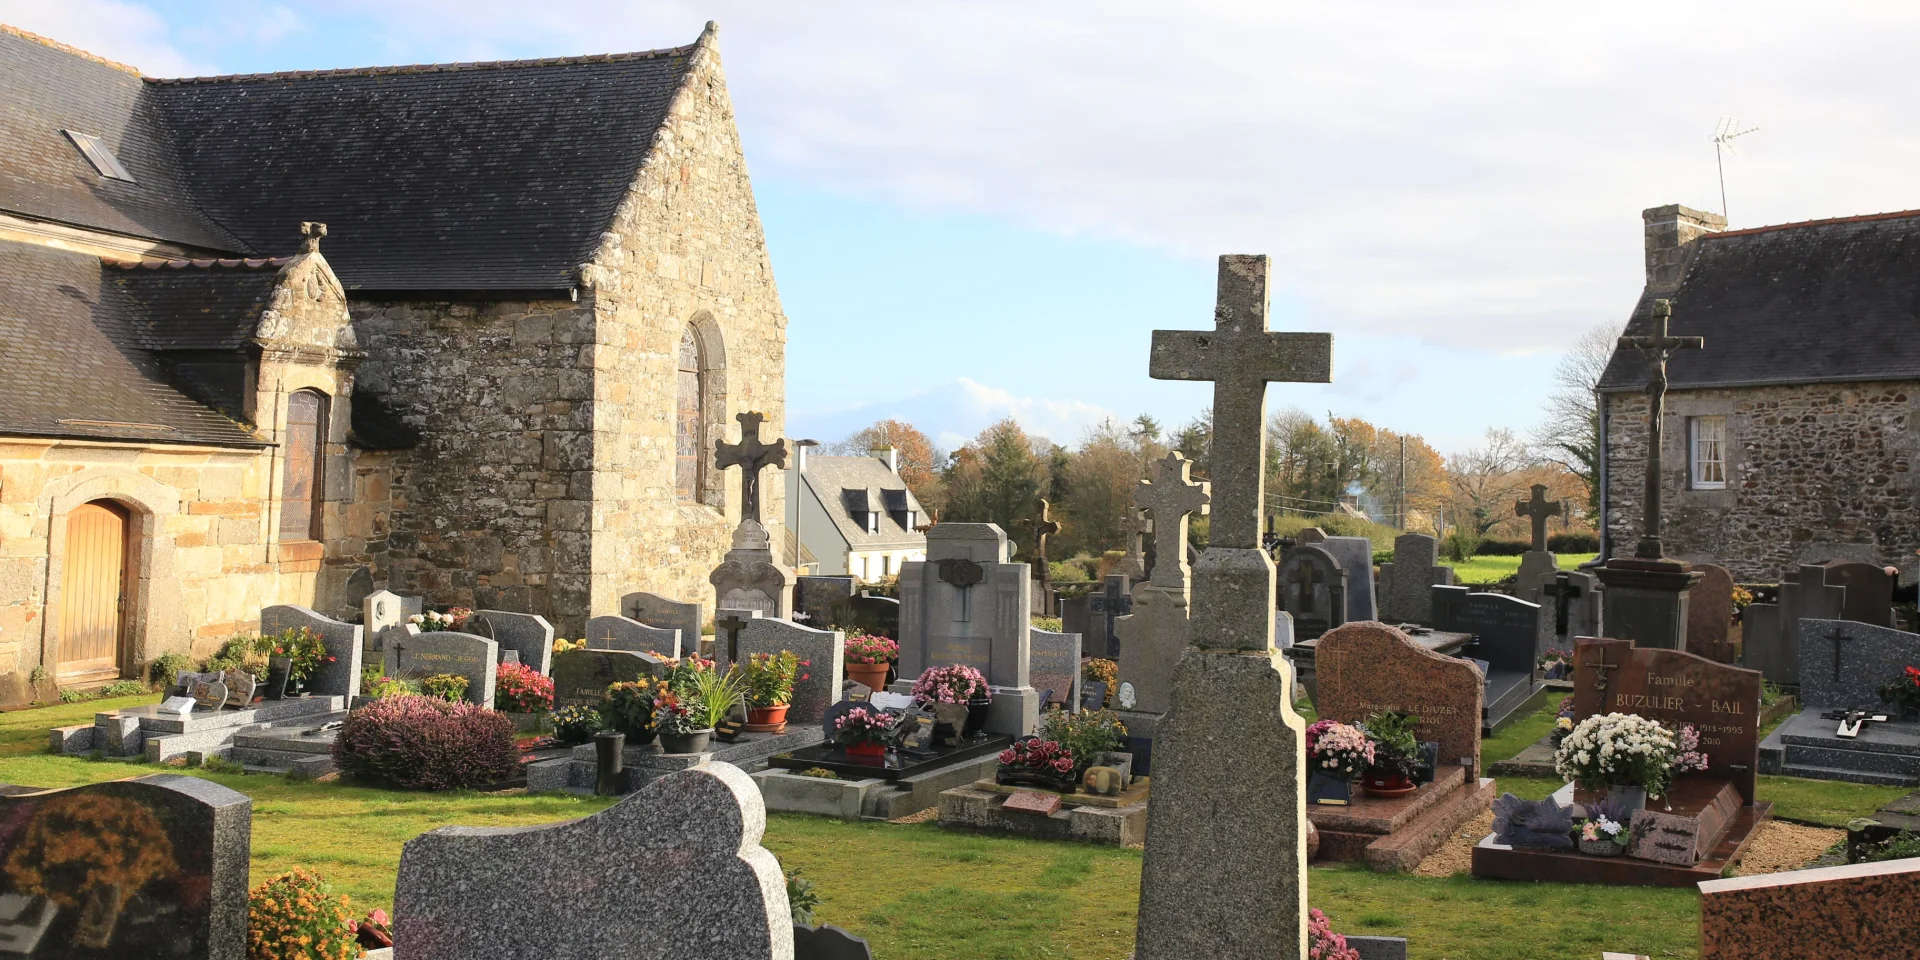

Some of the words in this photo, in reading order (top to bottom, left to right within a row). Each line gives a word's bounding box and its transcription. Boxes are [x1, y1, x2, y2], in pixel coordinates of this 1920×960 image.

[1648, 672, 1694, 687] Famille
[576, 687, 602, 696] FAMILLE
[1408, 704, 1420, 713] LE
[1616, 693, 1687, 713] BUZULIER
[1711, 700, 1744, 715] BAIL
[1702, 737, 1721, 746] 2010
